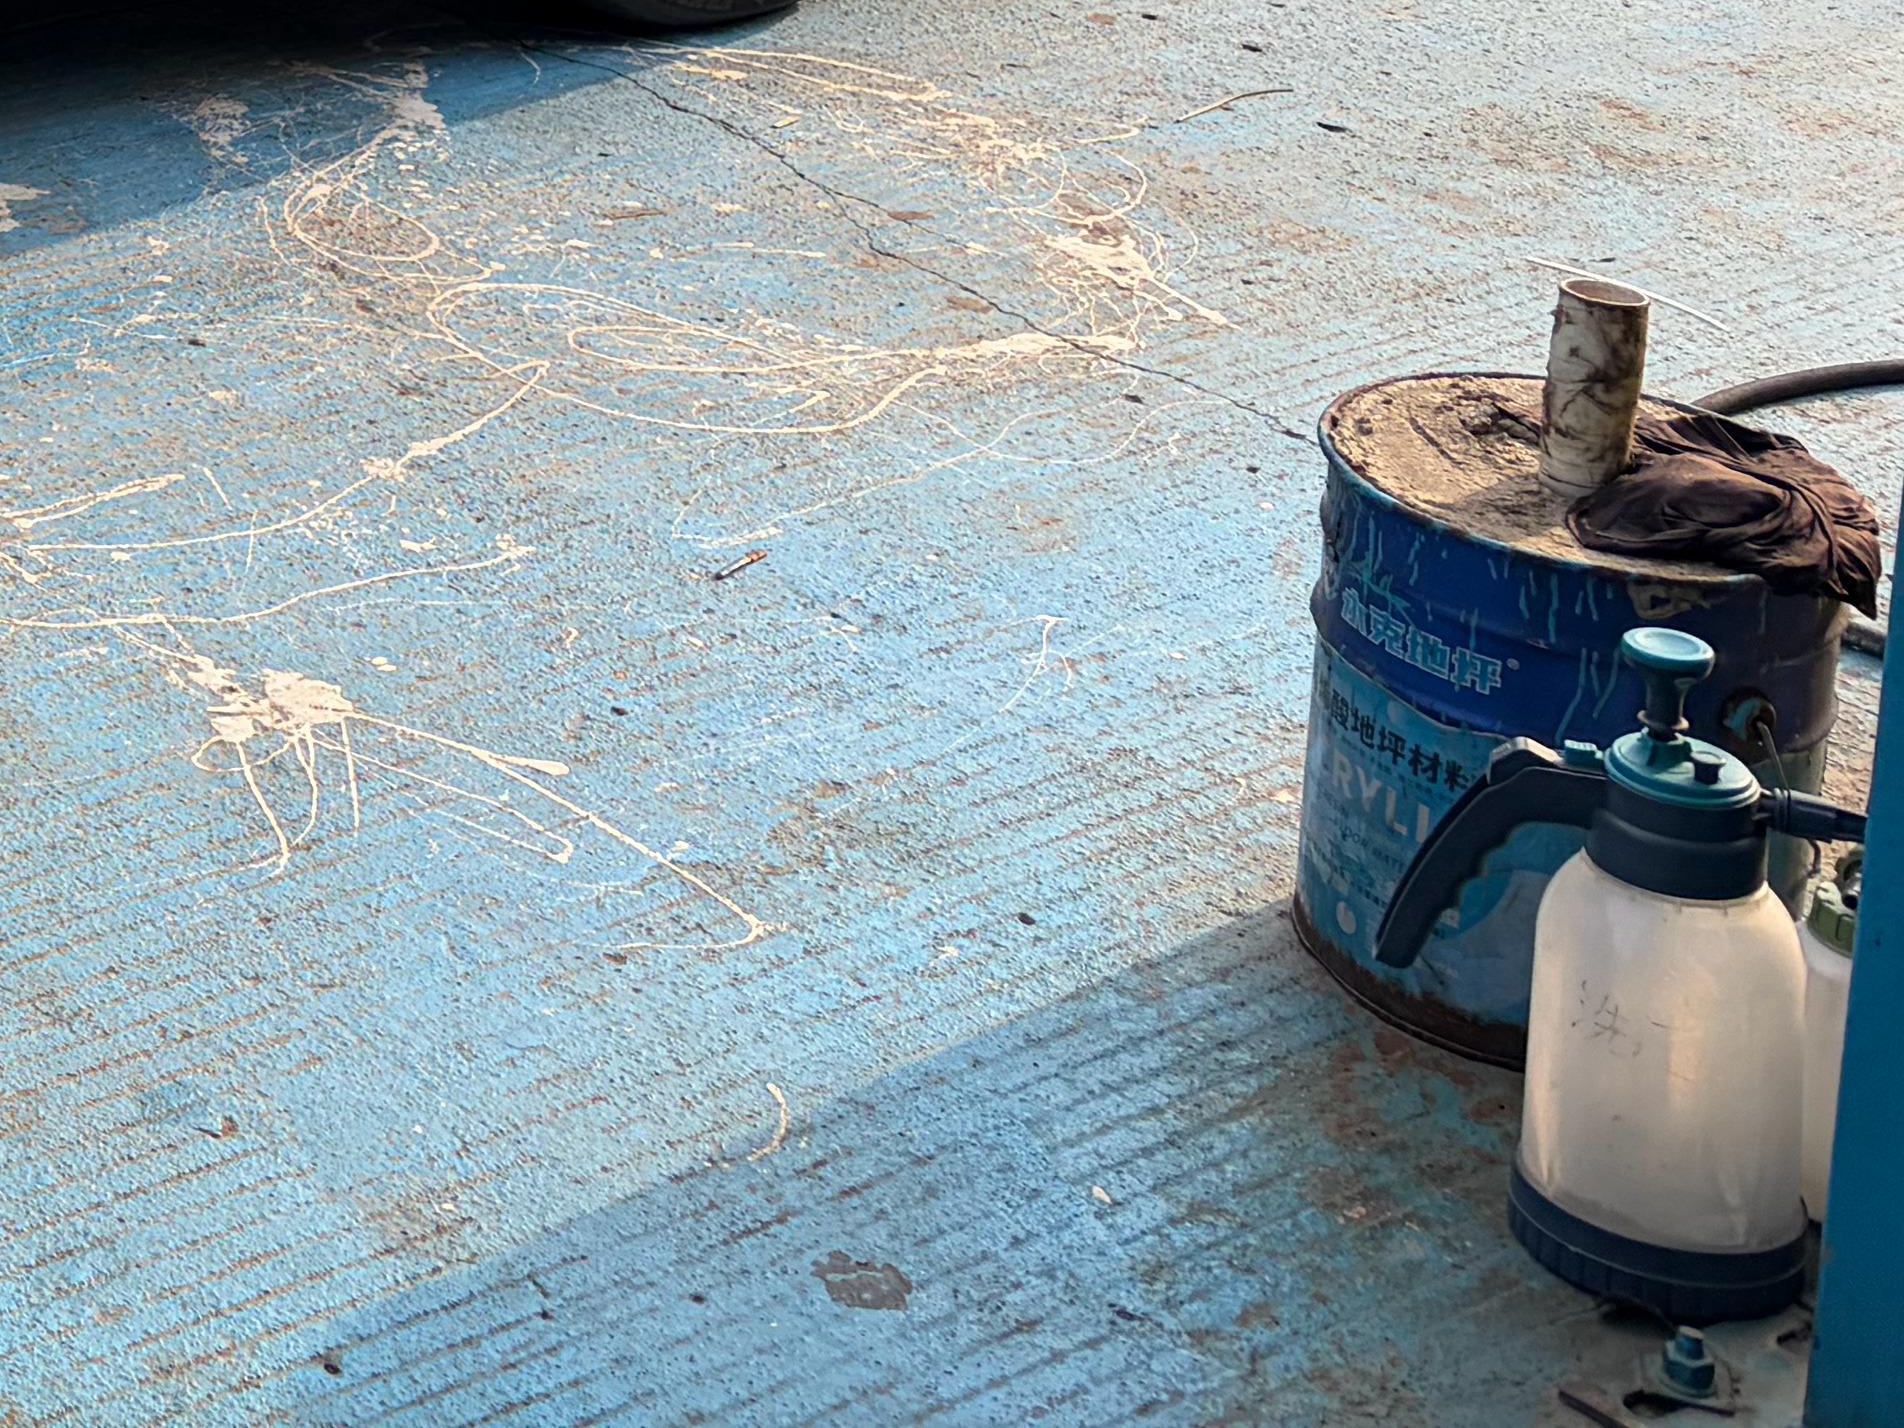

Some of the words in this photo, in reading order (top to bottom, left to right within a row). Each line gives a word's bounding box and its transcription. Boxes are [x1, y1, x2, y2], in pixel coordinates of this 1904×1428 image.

[1320, 682, 1474, 793] 酸地坪材料
